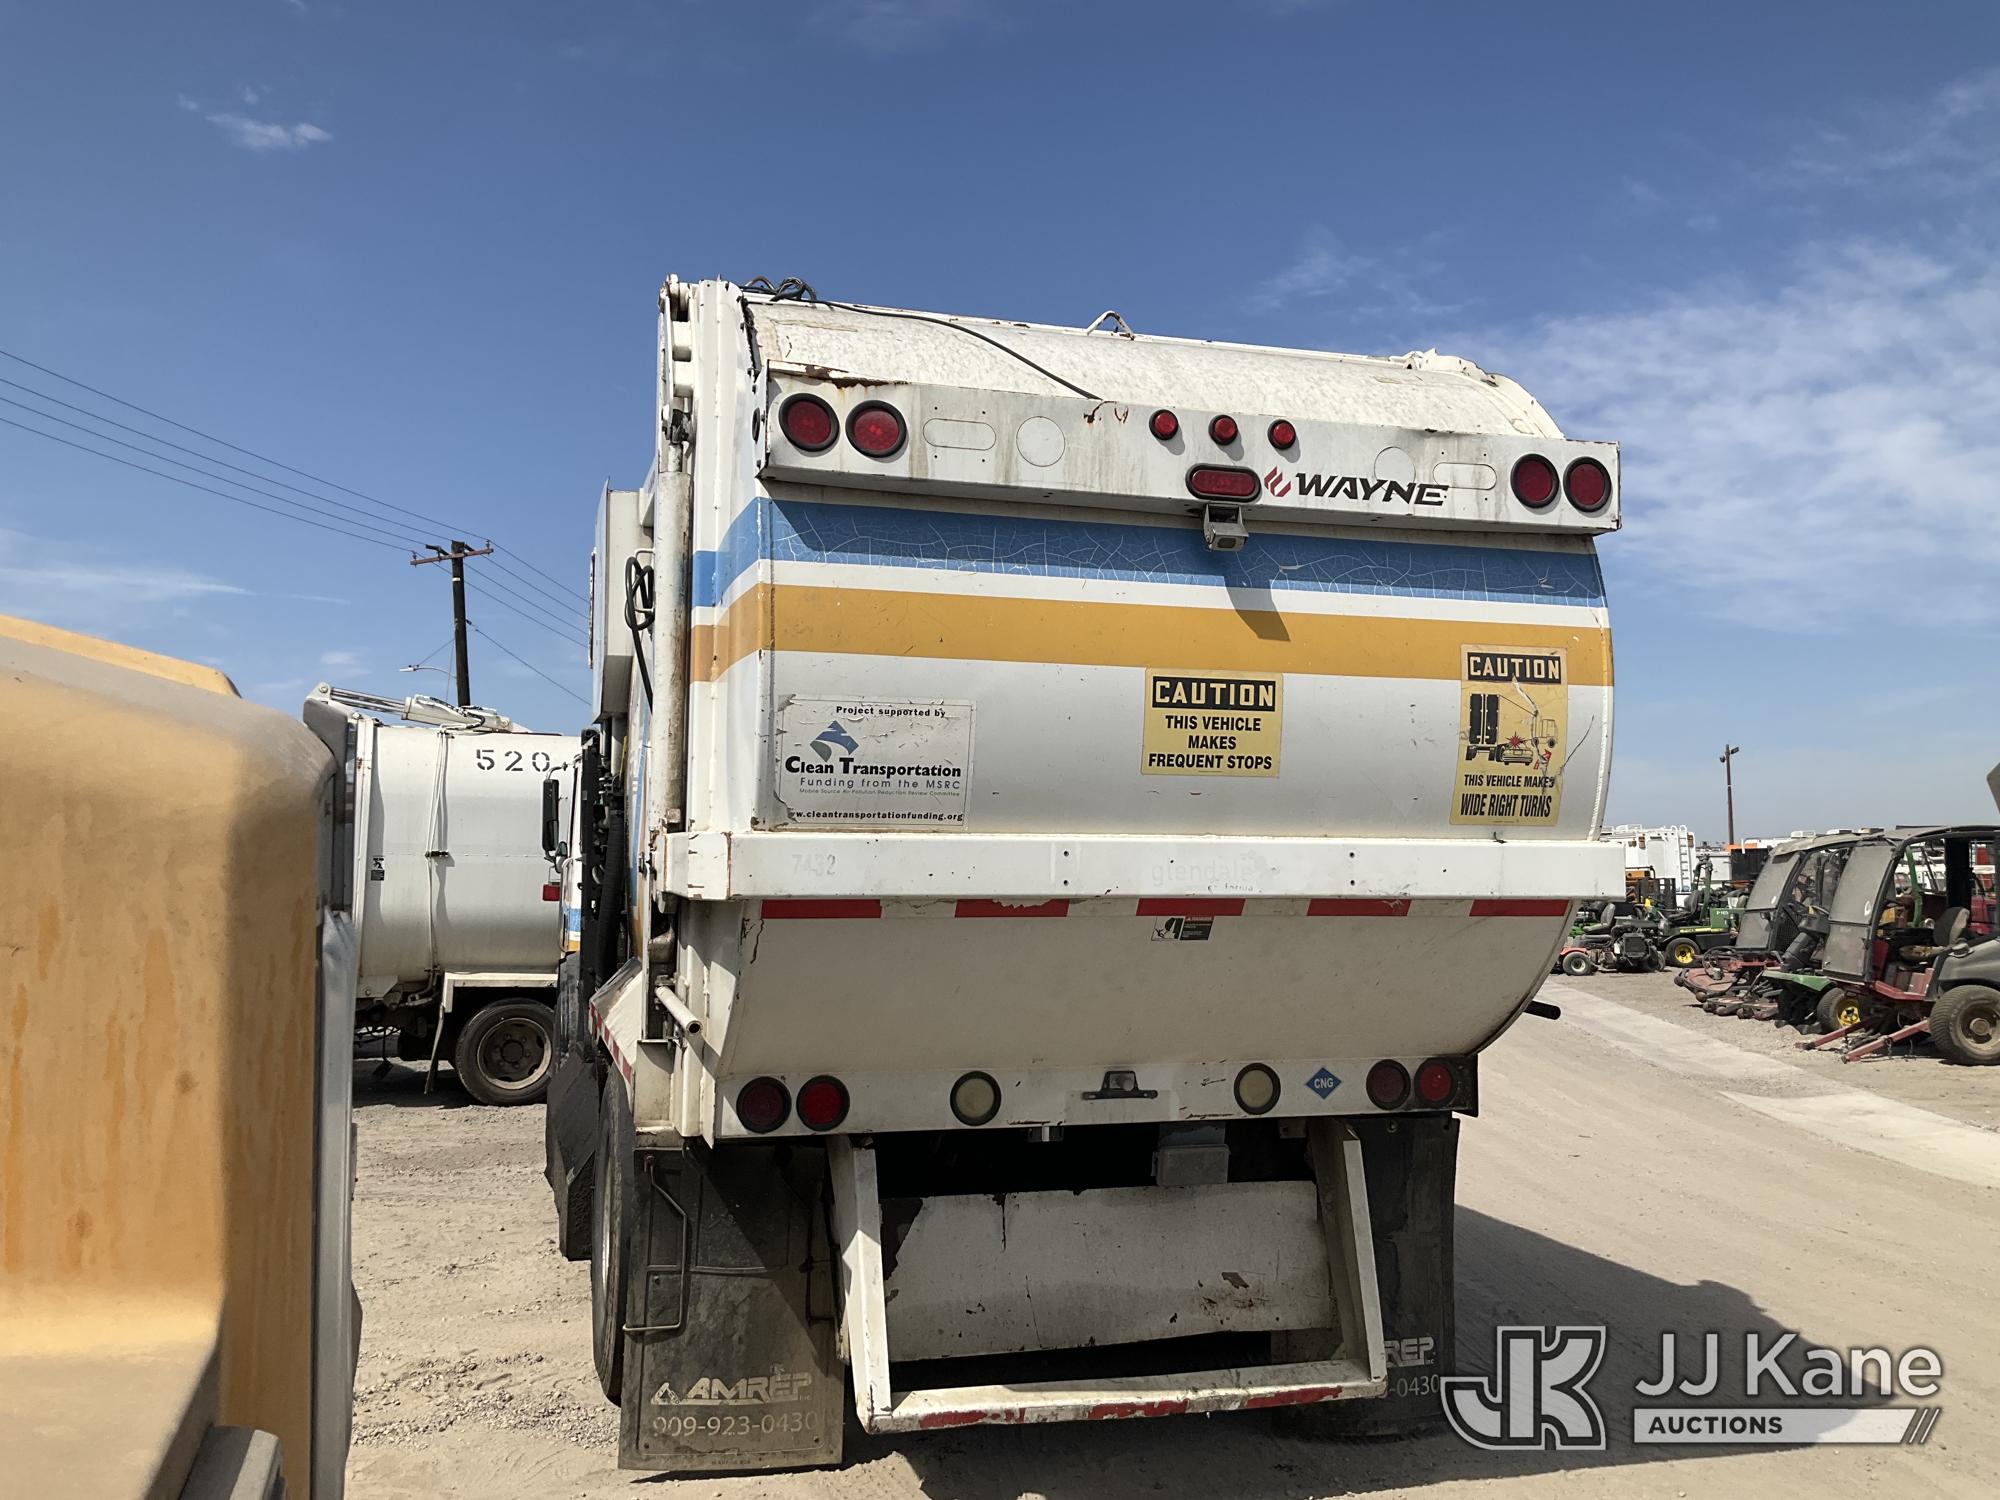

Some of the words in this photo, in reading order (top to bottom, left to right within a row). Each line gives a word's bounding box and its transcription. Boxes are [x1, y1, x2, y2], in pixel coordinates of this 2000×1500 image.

[1296, 472, 1450, 506] WAYNE
[1469, 656, 1560, 679] CAUTION
[1155, 680, 1273, 707] CAUTION
[836, 705, 874, 716] Project
[878, 706, 930, 717] supported
[934, 708, 946, 718] by
[1165, 715, 1198, 729] THIS
[1202, 716, 1262, 731] VEHICLE
[1188, 735, 1237, 750] MAKES
[476, 749, 551, 772] 520
[785, 755, 834, 774] Clean
[839, 757, 962, 779] Transportation
[1148, 753, 1224, 769] FREQUENT
[1227, 755, 1273, 770] STOPS
[800, 777, 854, 788] Funding
[861, 778, 891, 788] from
[898, 779, 919, 788] the
[926, 780, 961, 790] MSRC
[1464, 774, 1484, 786] THIS
[1486, 774, 1522, 787] VEHICLE
[1523, 775, 1555, 788] MAKES
[1460, 793, 1487, 816] WIDE
[1487, 794, 1519, 817] RIGHT
[1519, 794, 1552, 818] TURNS
[1314, 1077, 1334, 1089] CNG
[1384, 1336, 1435, 1367] REP
[685, 1372, 813, 1403] AMREP
